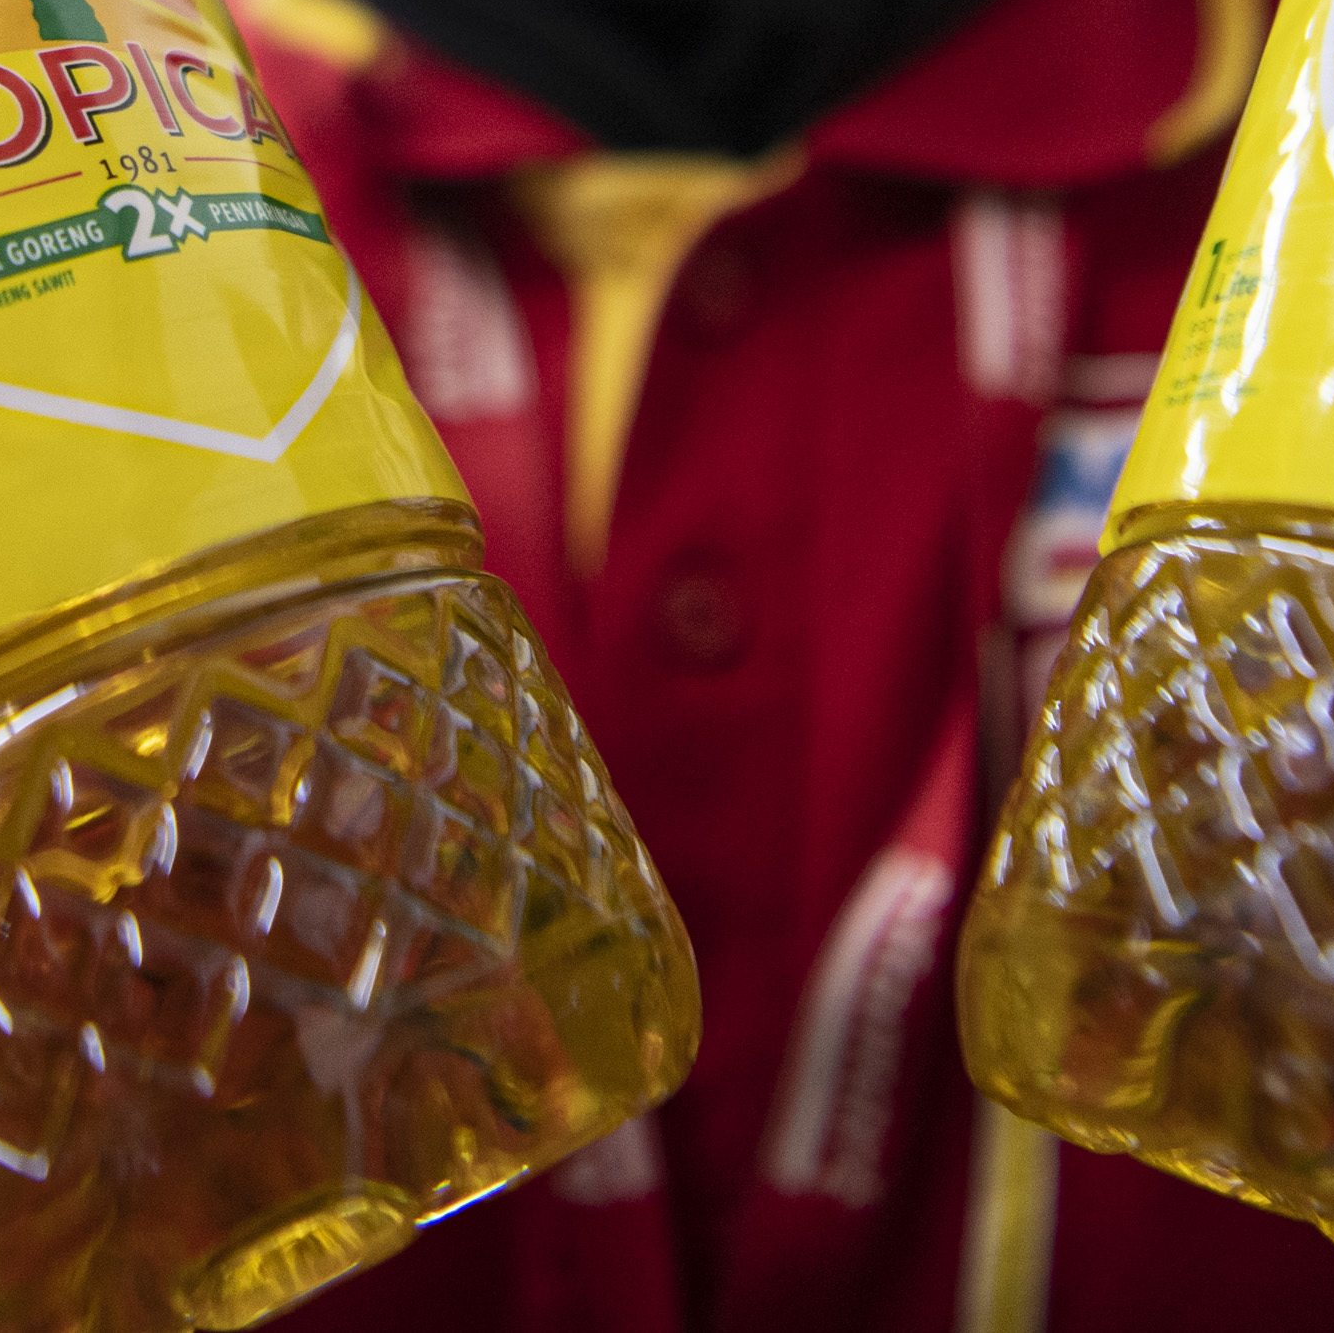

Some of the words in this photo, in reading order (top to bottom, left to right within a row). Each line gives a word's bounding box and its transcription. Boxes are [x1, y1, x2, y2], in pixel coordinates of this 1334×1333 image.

[99, 145, 178, 183] 1981
[5, 219, 105, 267] GORENG
[104, 189, 206, 258] 2x
[208, 201, 311, 233] PENYARINGAN
[32, 269, 77, 299] SAWIT
[1200, 238, 1228, 309] 1
[1214, 270, 1267, 305] Lite
